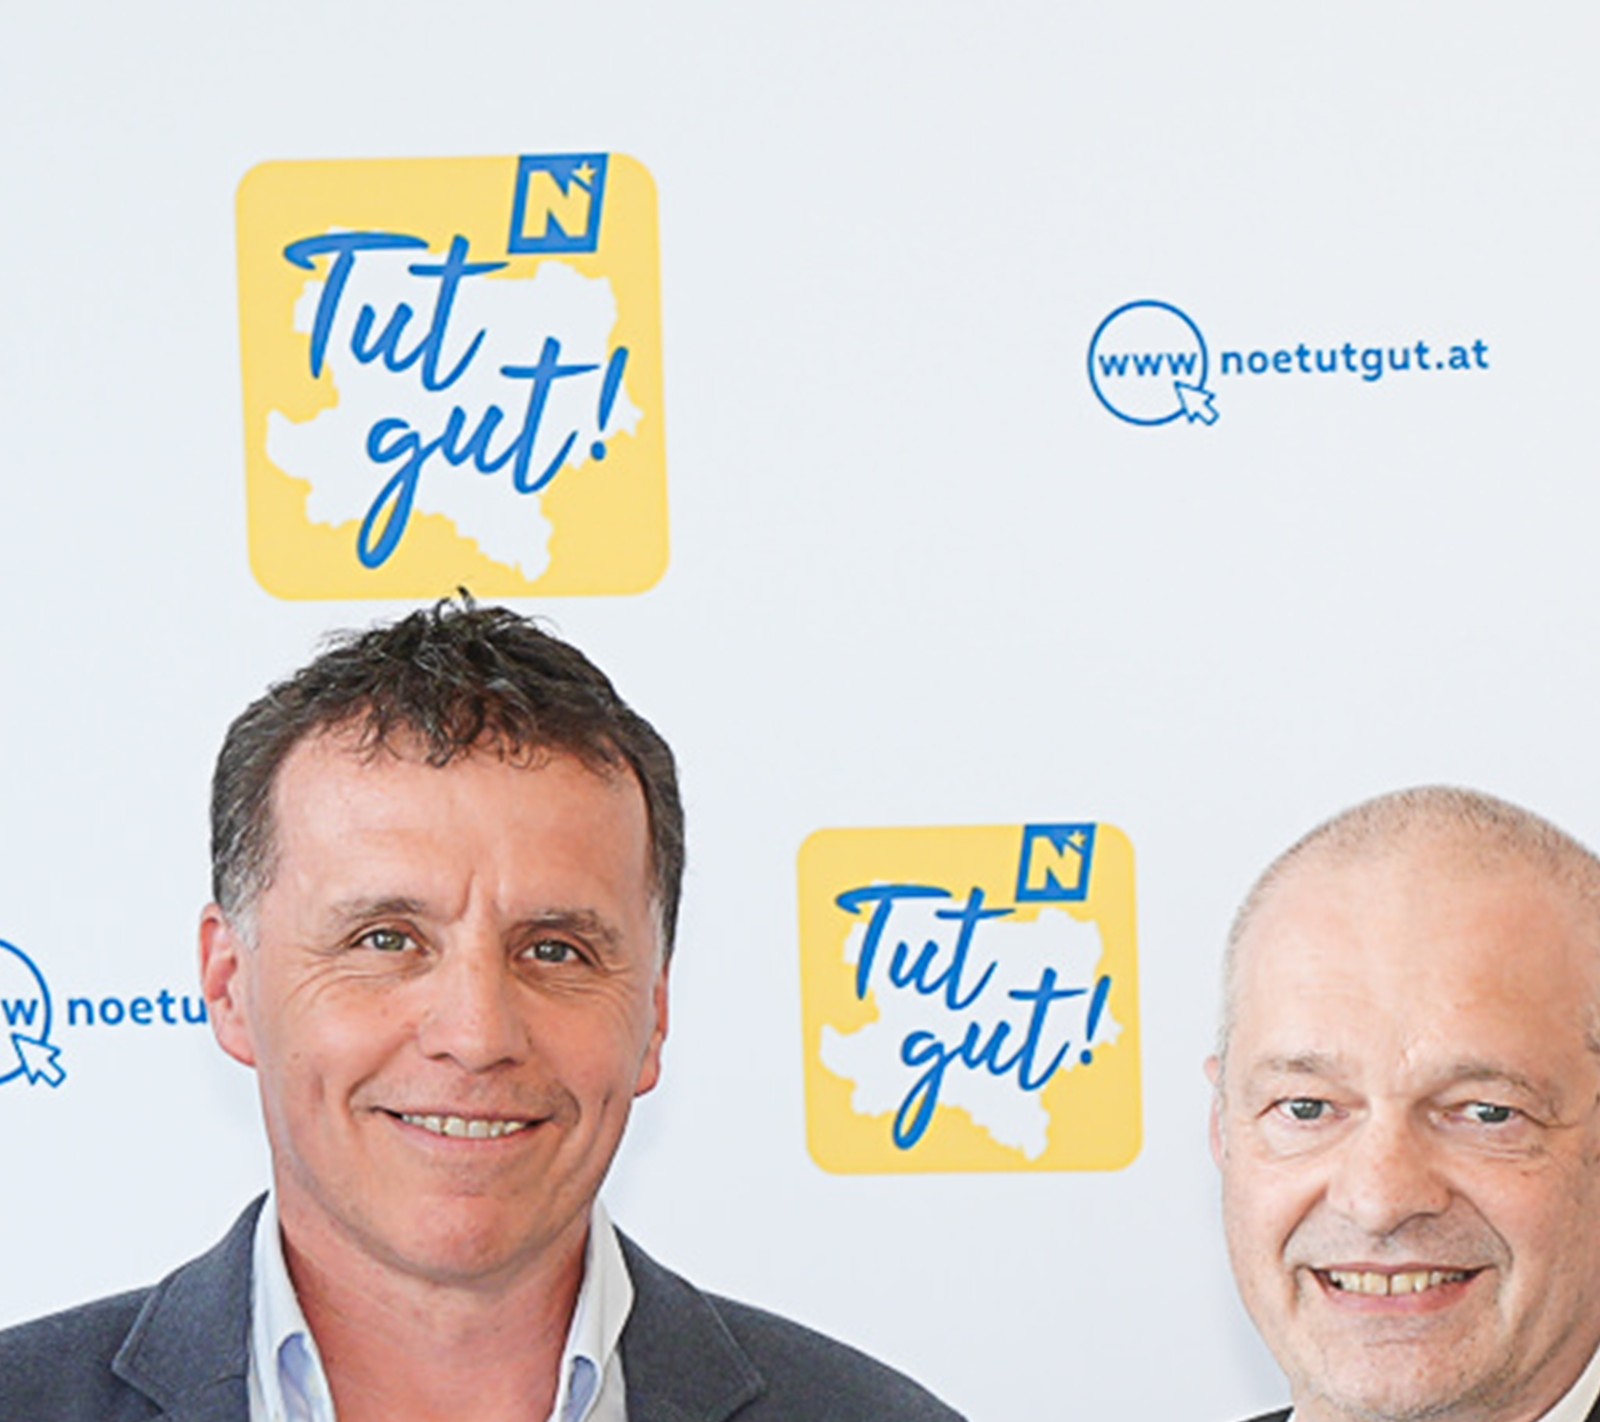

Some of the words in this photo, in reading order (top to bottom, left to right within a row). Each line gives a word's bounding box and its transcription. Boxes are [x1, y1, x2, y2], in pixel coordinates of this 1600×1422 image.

[285, 232, 506, 393] Tut
[1099, 353, 1198, 377] www
[1221, 339, 1489, 383] noetutgut.at
[358, 336, 629, 569] gut!
[837, 885, 1012, 1012] Tut
[893, 967, 1112, 1150] gut!
